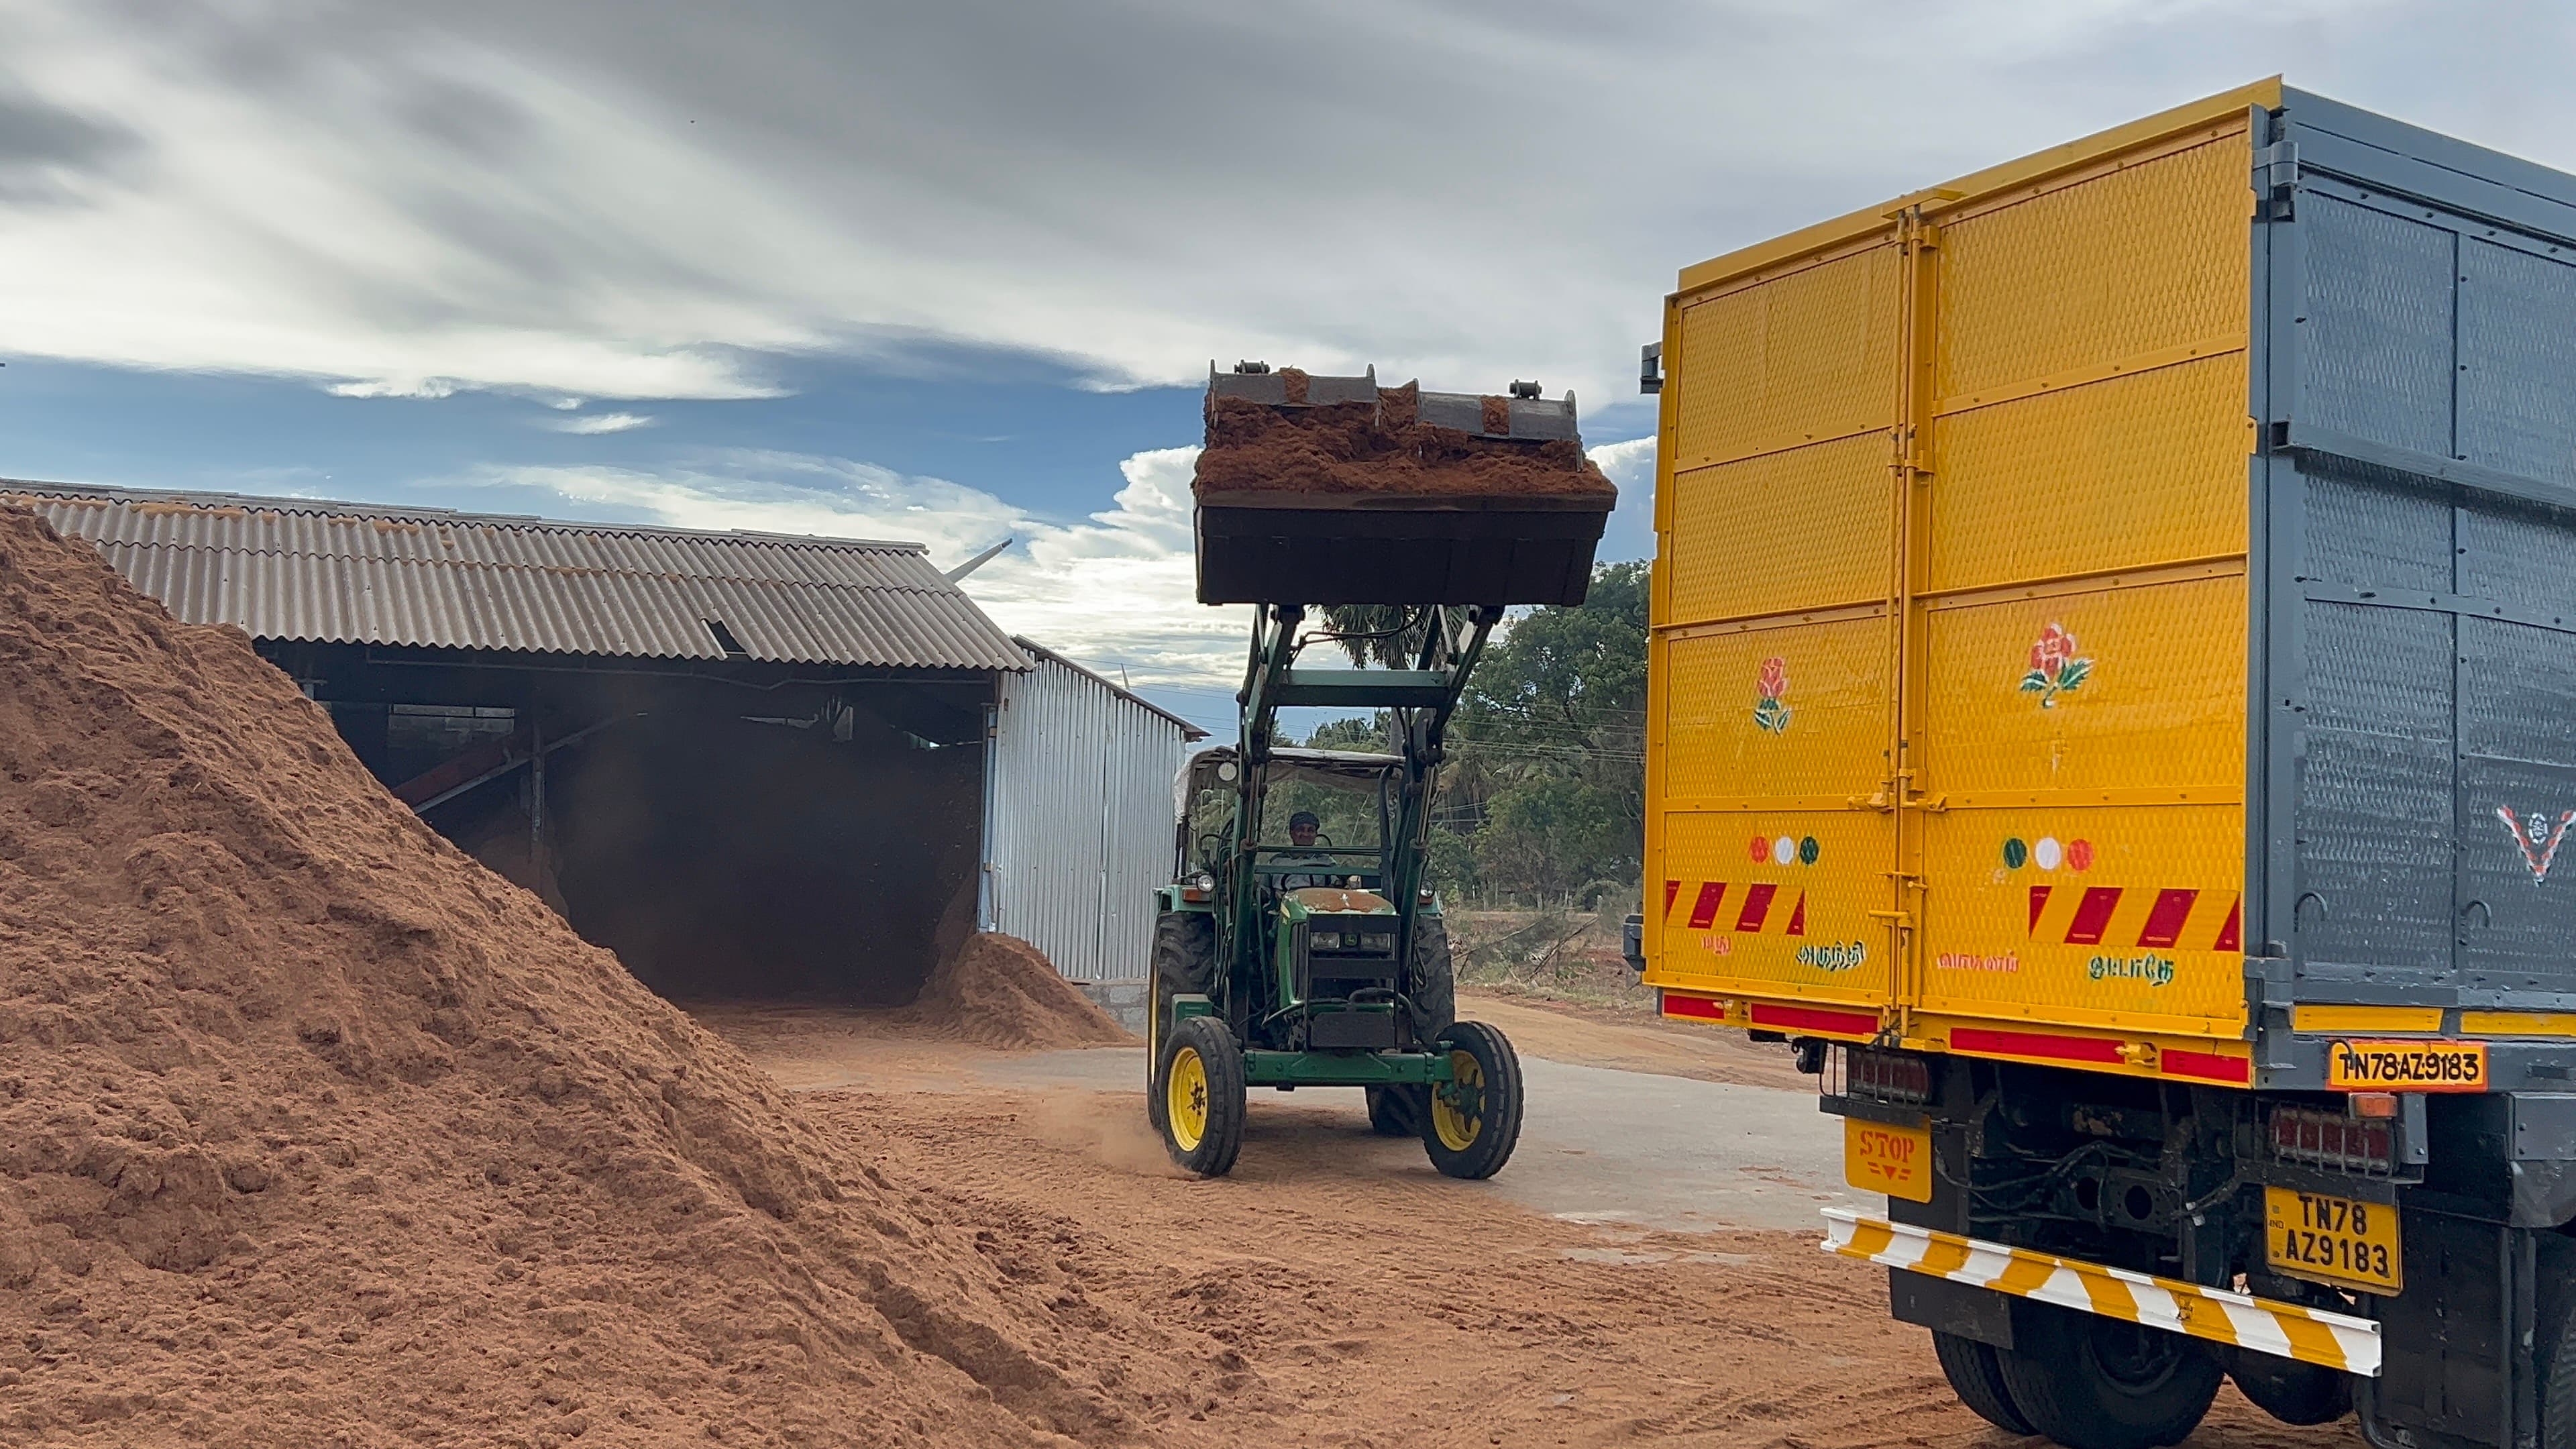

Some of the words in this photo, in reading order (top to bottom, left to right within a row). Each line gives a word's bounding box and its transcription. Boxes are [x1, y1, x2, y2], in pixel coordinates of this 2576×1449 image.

[1859, 1130, 1915, 1164] STOP
[2269, 1220, 2284, 1229] IND
[2298, 1195, 2367, 1236] TN78
[2286, 1228, 2390, 1279] AZ9183
